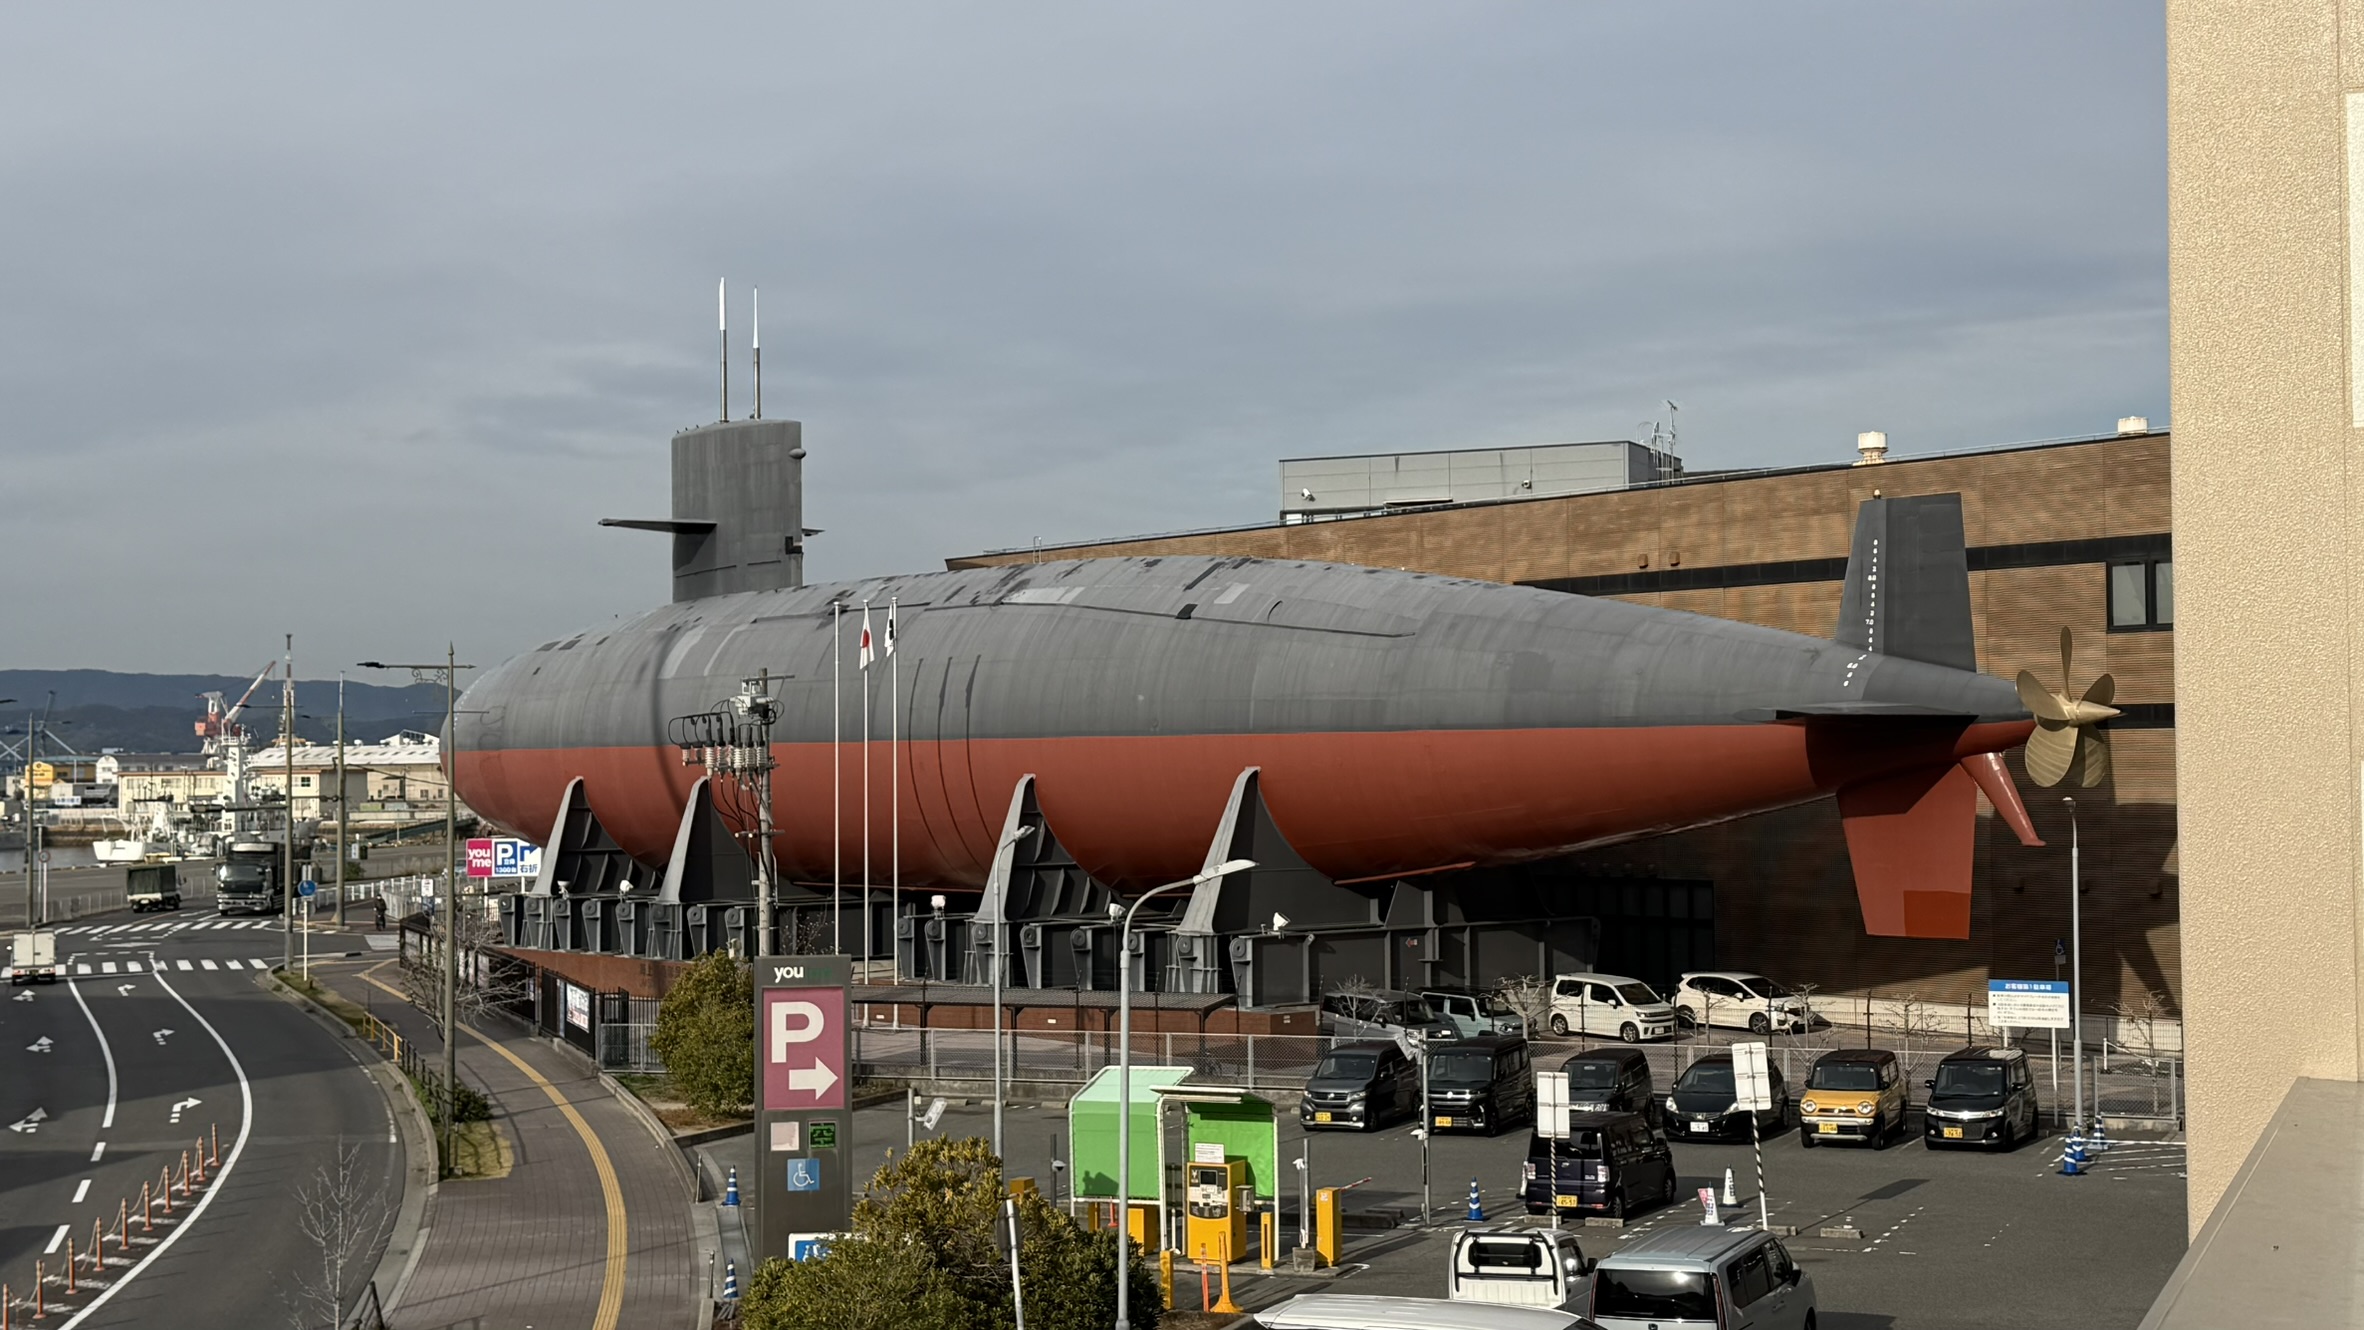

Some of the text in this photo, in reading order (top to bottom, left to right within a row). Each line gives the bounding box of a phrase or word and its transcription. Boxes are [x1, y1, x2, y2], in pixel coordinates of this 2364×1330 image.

[468, 848, 490, 860] you
[497, 844, 513, 865] P
[472, 858, 491, 867] me
[520, 864, 537, 873] 右折
[774, 966, 804, 983] you
[771, 1001, 825, 1063] P
